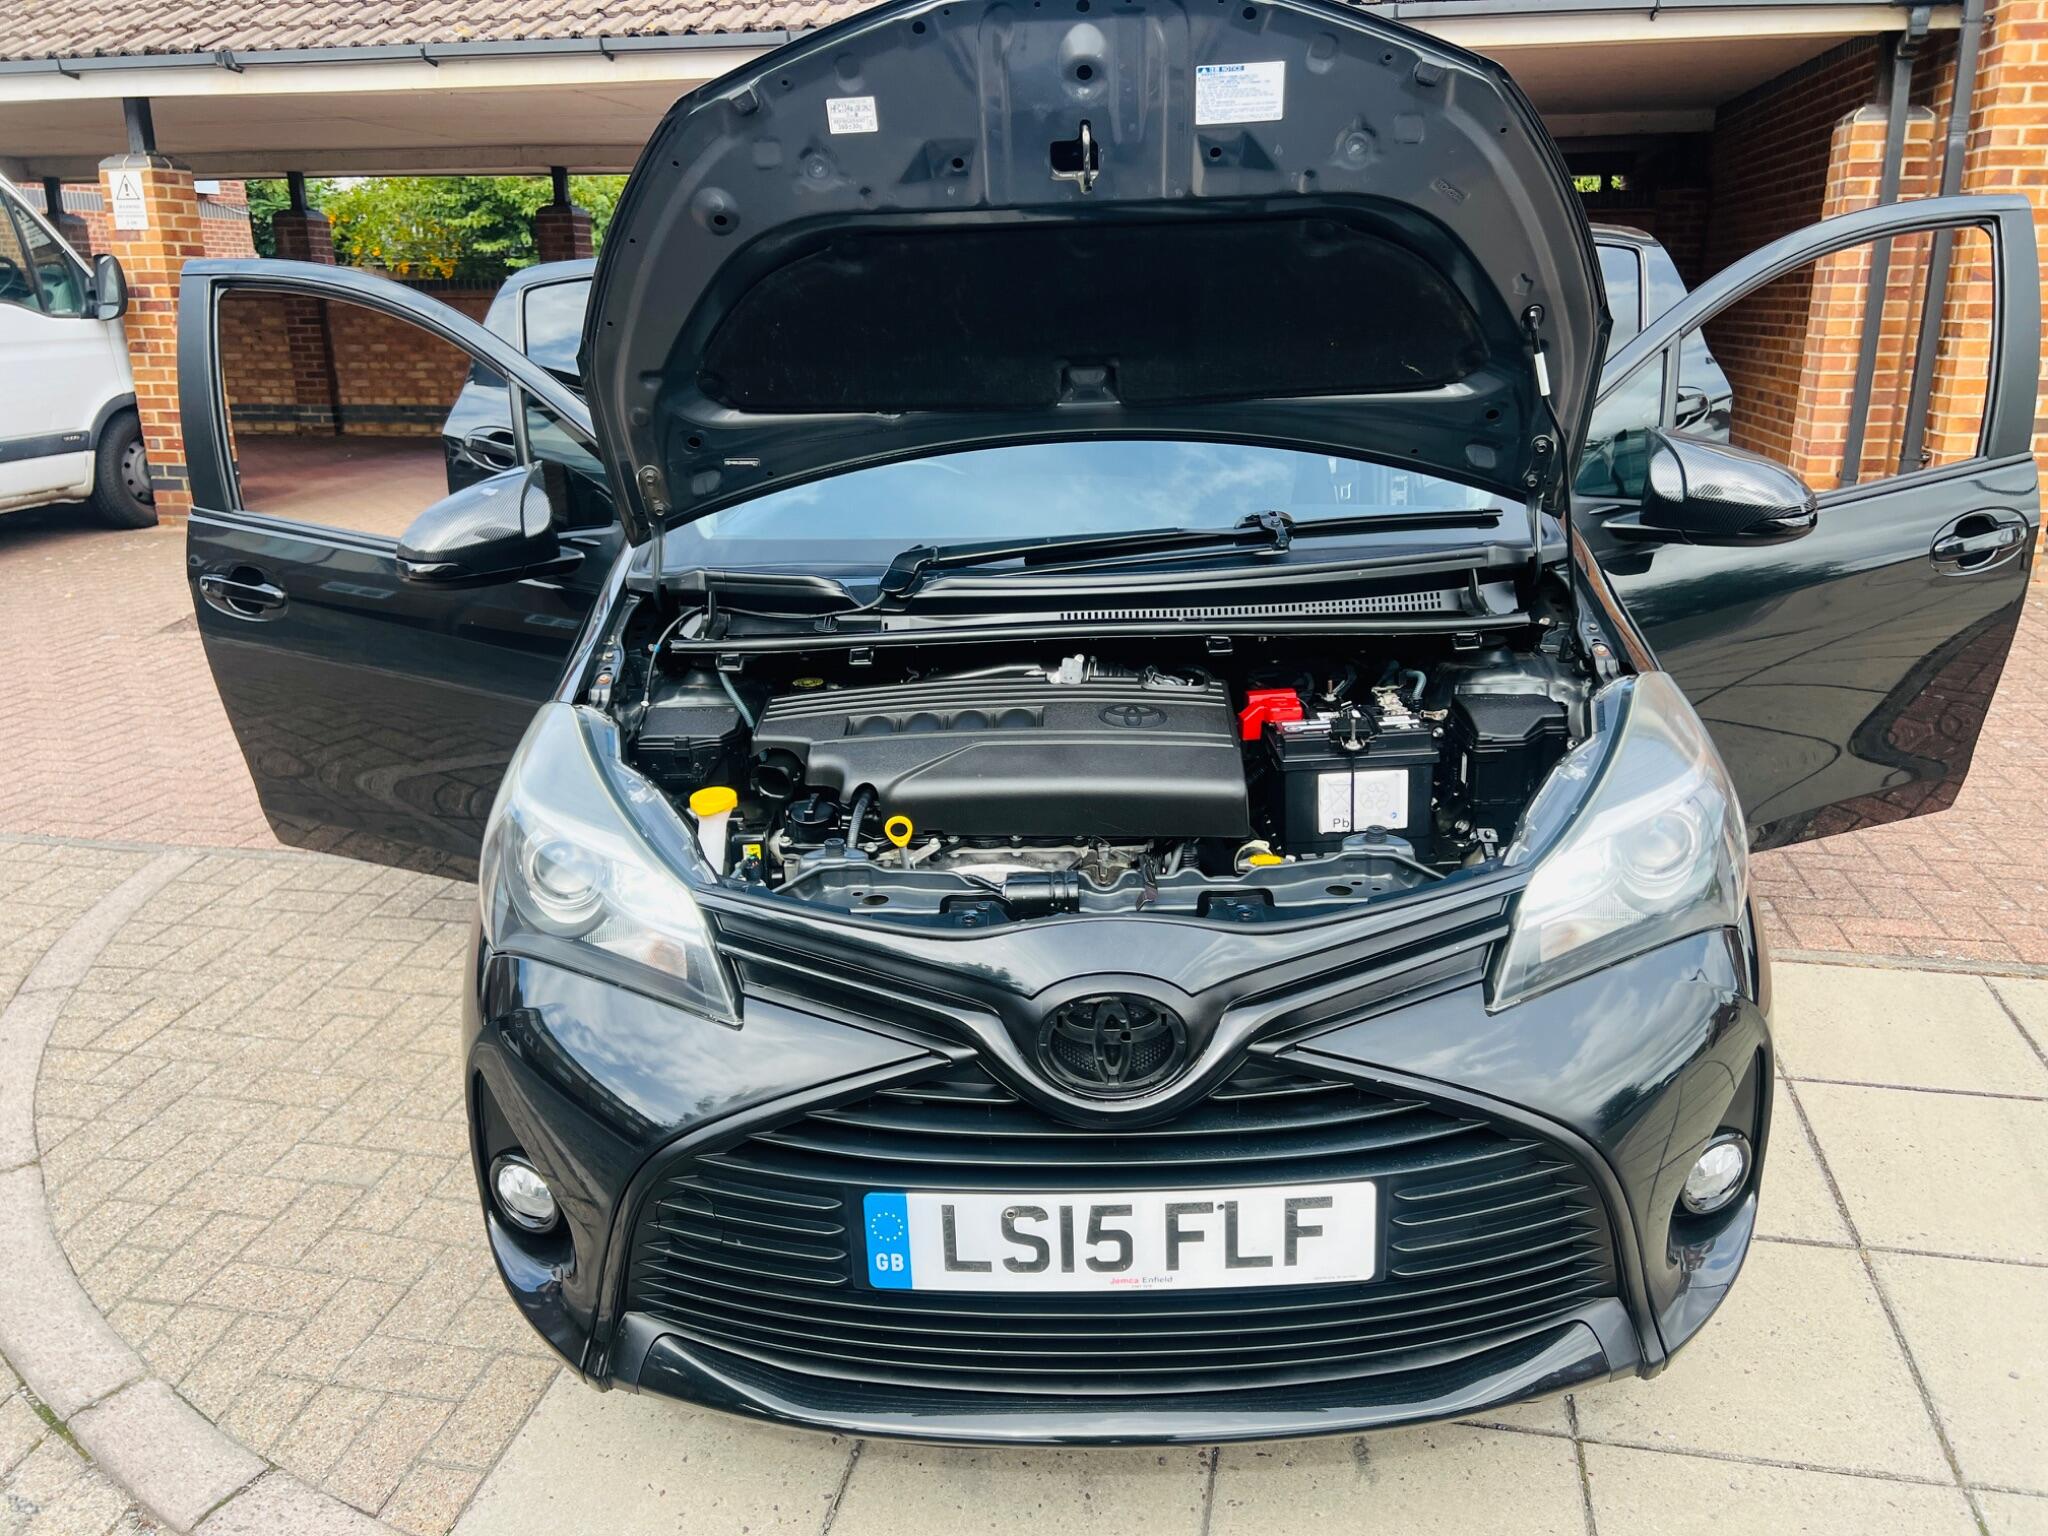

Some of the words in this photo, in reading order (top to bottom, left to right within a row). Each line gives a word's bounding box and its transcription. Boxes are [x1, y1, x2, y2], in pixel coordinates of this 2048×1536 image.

[1333, 818, 1350, 828] Pb
[941, 1204, 1134, 1273] LS15
[1165, 1196, 1333, 1271] FLF
[875, 1252, 904, 1272] GB
[1142, 1275, 1173, 1284] Enfield
